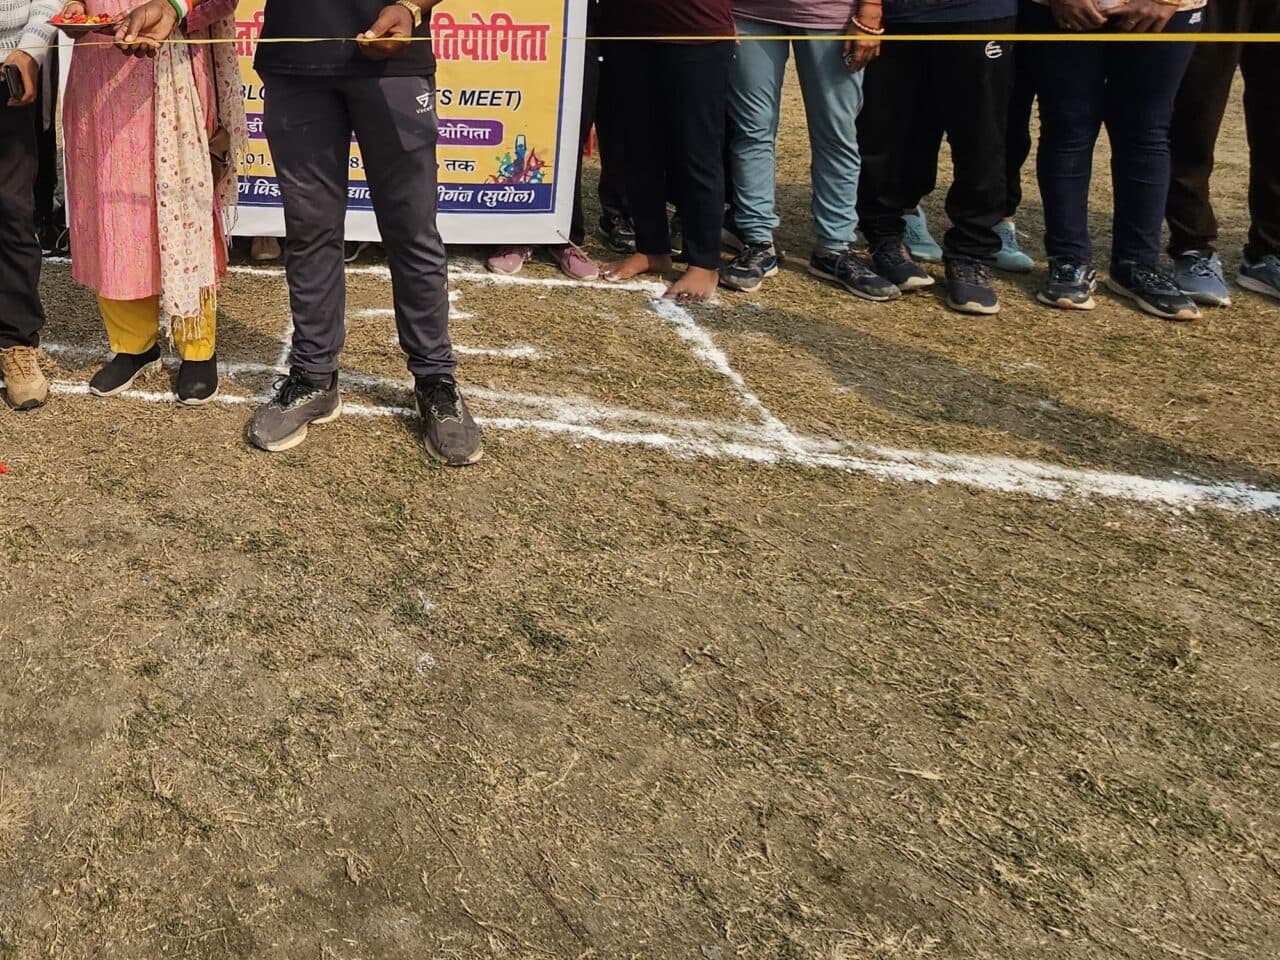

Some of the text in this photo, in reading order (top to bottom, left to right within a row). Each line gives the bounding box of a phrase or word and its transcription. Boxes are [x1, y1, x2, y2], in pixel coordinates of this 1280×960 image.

[431, 12, 551, 61] तियोगिता
[458, 89, 522, 111] MEET)
[437, 123, 492, 140] योगिता
[443, 159, 476, 172] तक
[477, 187, 536, 208] (सुपौल)
